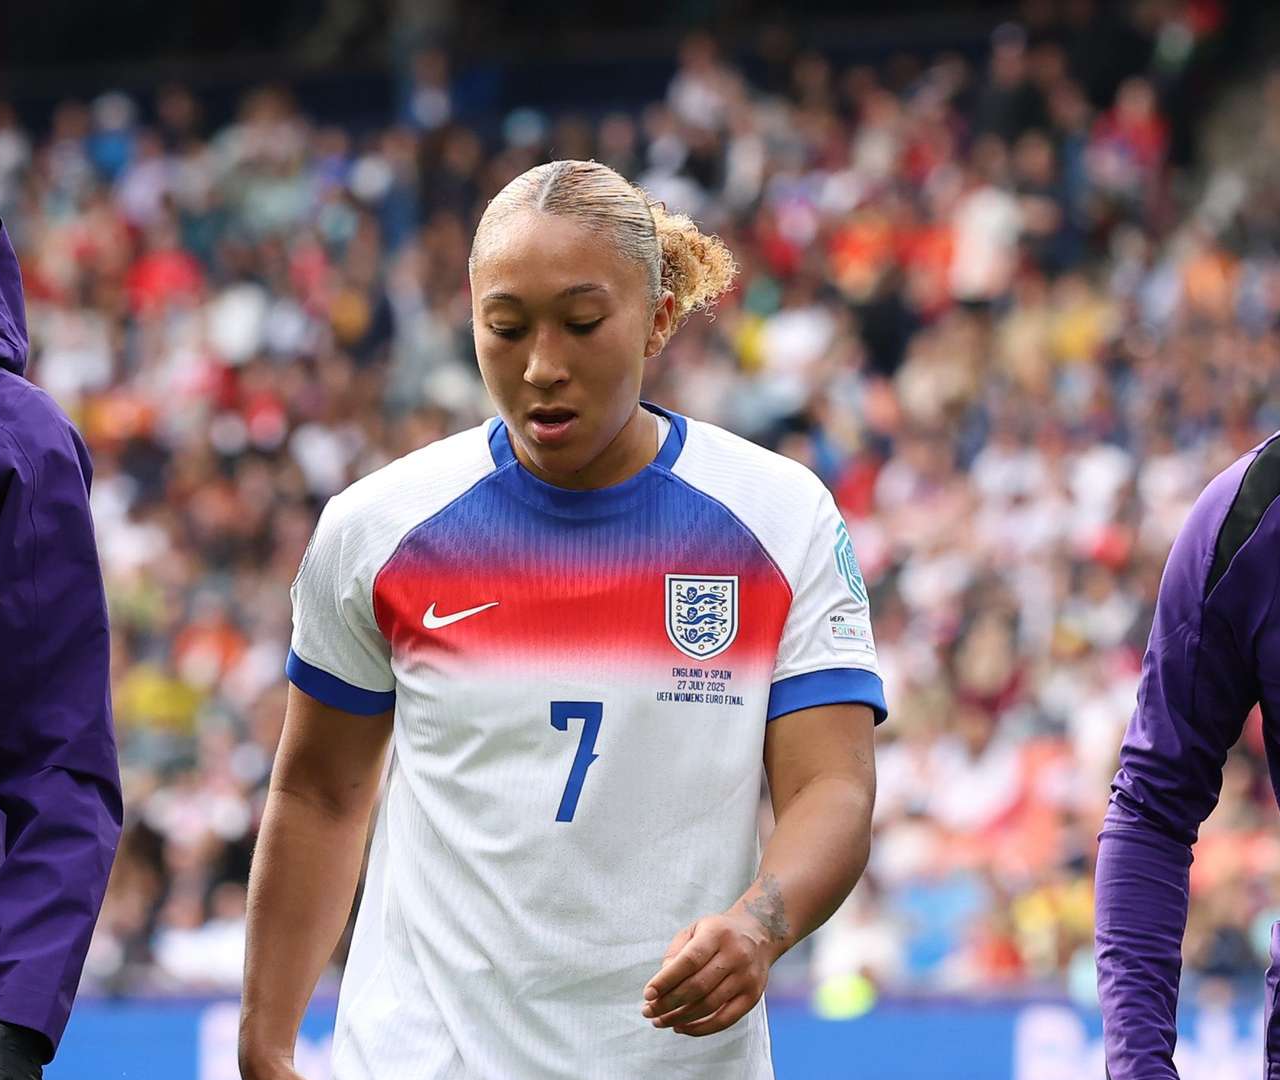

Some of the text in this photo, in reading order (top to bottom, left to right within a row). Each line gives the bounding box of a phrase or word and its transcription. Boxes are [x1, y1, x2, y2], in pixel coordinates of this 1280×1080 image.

[672, 667, 702, 678] ENGLAND
[711, 669, 732, 680] SPAIN
[677, 680, 726, 692] 27 JULY 2025
[656, 691, 744, 706] UEFA WOMENS EURO FINAL
[550, 701, 603, 822] 7
